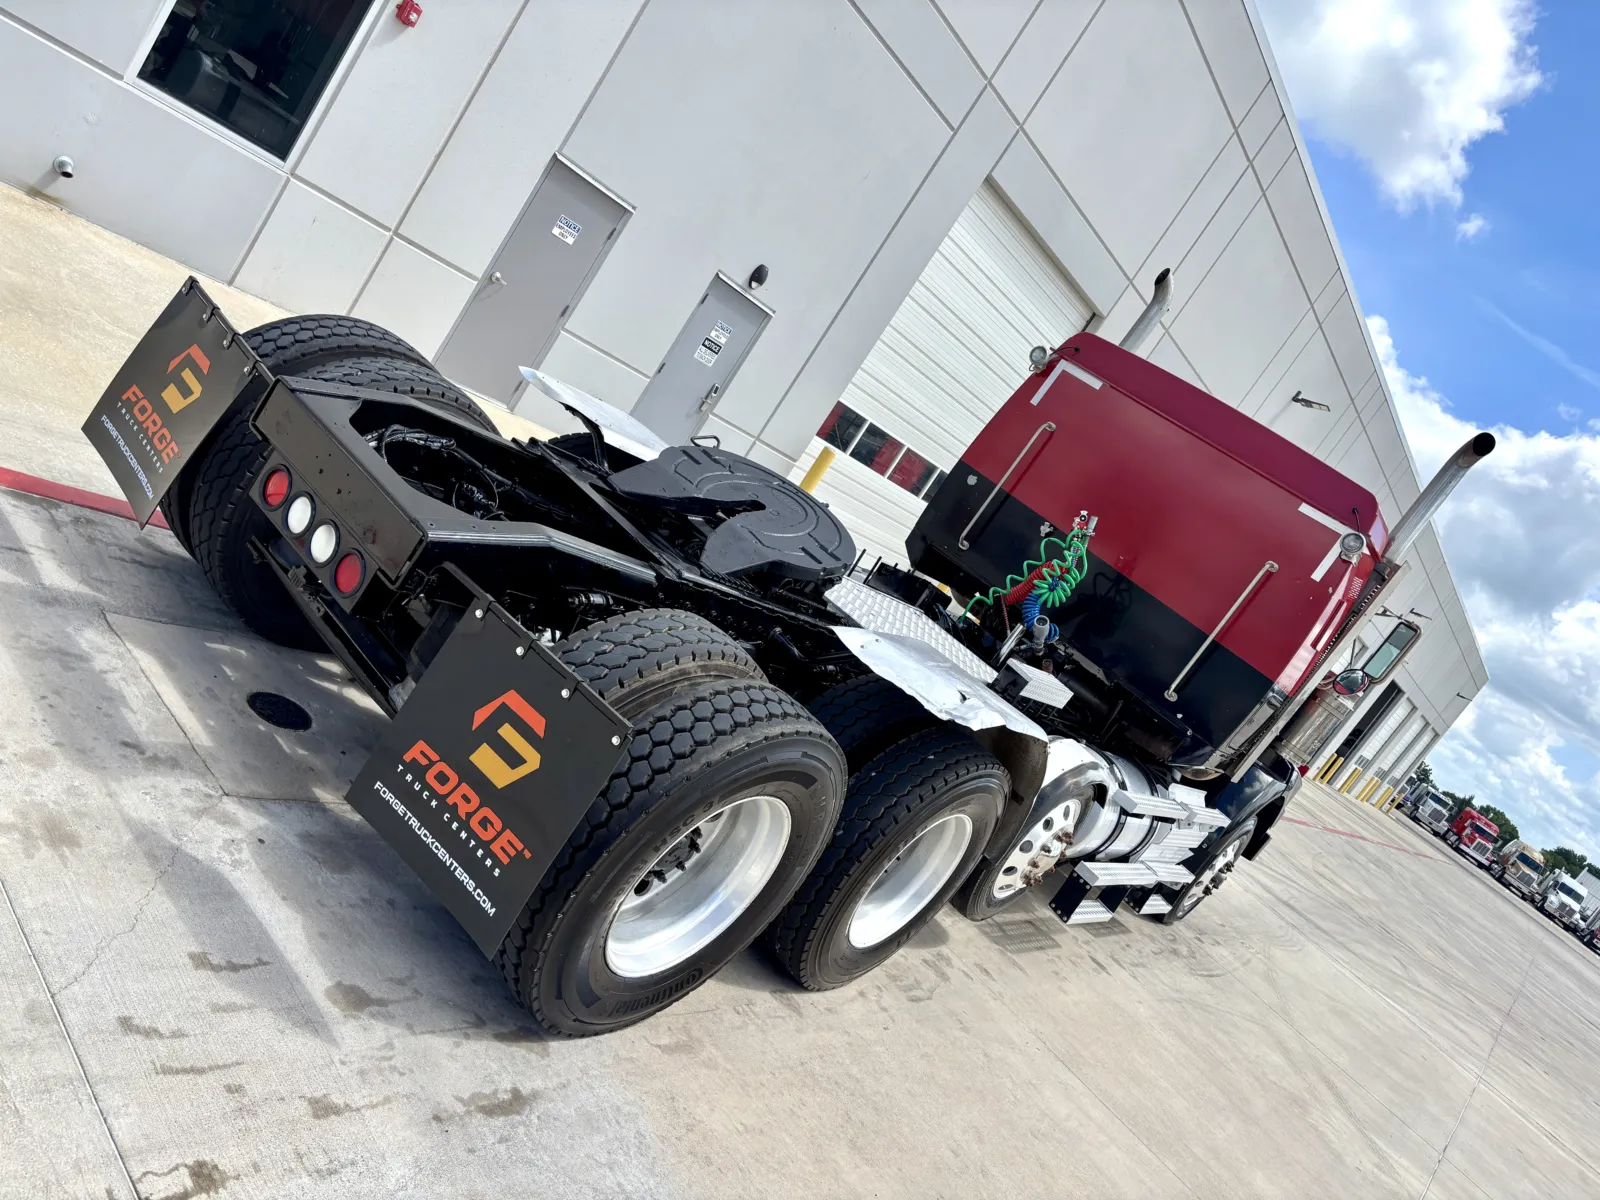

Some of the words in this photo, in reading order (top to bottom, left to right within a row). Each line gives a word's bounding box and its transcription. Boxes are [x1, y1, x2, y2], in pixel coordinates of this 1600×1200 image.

[555, 222, 577, 239] EMPLOYEES
[560, 216, 580, 233] NOTICE
[703, 339, 721, 353] NOTICE
[100, 414, 154, 501] FORGETRUCKCENTERS.COM
[116, 401, 138, 432] TRUCK
[138, 434, 164, 474] CENTERS
[121, 384, 179, 465] FORGE
[396, 764, 438, 809] TRUCK
[443, 812, 501, 877] CENTERS
[402, 739, 524, 866] FORGE
[652, 813, 696, 853] HSC
[373, 780, 497, 917] FORGETRUCKCENTERS.COM
[607, 967, 704, 1018] Continental
